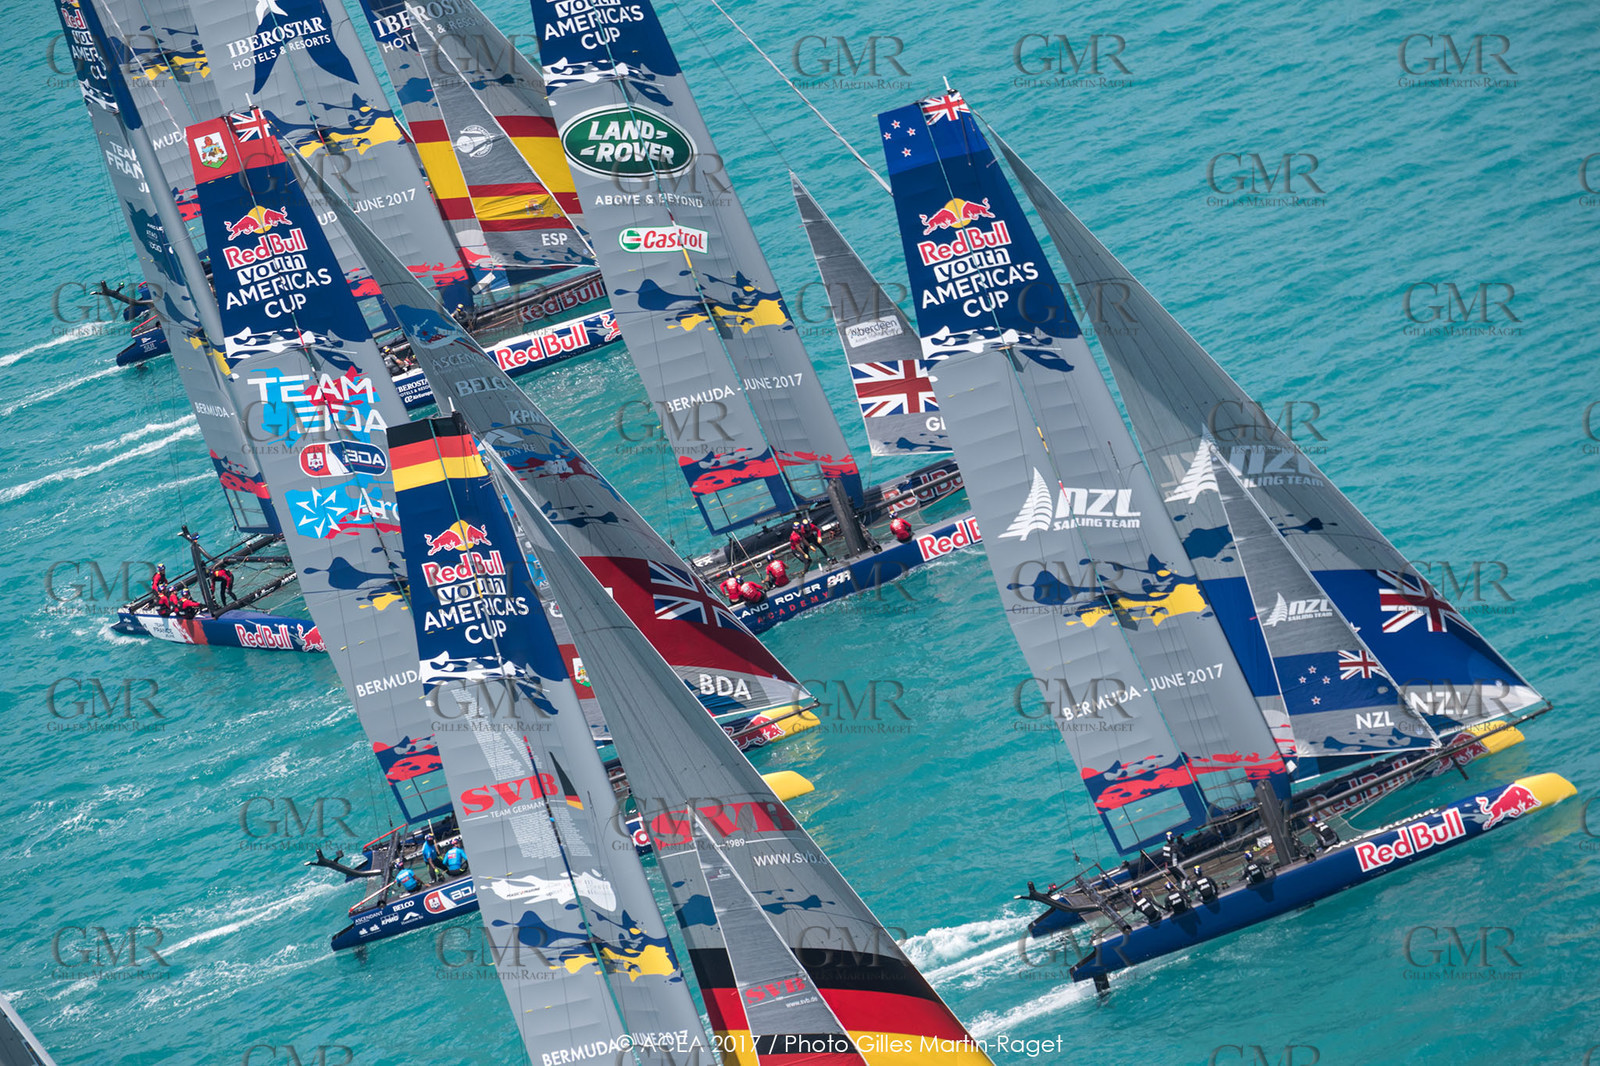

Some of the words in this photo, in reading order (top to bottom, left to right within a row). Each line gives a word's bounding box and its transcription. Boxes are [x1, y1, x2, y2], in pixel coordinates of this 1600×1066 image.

[545, 5, 644, 41] AMERICA'S
[227, 17, 326, 59] IBEROSTAR
[581, 26, 620, 50] CUP
[233, 49, 278, 71] HOTELS
[279, 45, 288, 56] &
[289, 34, 331, 52] RESORTS
[589, 120, 656, 141] LAND
[594, 142, 675, 165] ROVER
[354, 196, 384, 213] JUNE
[386, 188, 416, 206] 2017
[595, 194, 640, 206] ABOVE
[645, 194, 653, 204] &
[659, 193, 703, 208] BEYOND
[223, 235, 271, 270] Red
[267, 228, 308, 255] Bull
[541, 233, 568, 246] ESP
[644, 229, 704, 250] Castrol
[917, 235, 971, 266] Red
[967, 221, 1012, 249] Bull
[921, 262, 1038, 309] AMERICA'S
[264, 293, 306, 318] CUP
[517, 295, 561, 324] Red
[963, 290, 1009, 317] CUP
[495, 337, 544, 371] Red
[543, 321, 591, 357] Bull
[247, 373, 374, 403] TEAM
[666, 385, 734, 412] BERMUDA
[744, 377, 773, 391] JUNE
[773, 372, 803, 388] 2017
[194, 402, 230, 418] BERMUDA
[295, 404, 388, 434] BDA
[1055, 487, 1141, 519] NZL
[1053, 517, 1103, 531] SAILING
[1105, 518, 1140, 529] TEAM
[916, 520, 970, 561] Red
[421, 552, 475, 588] Red
[472, 550, 506, 576] Bull
[757, 591, 828, 623] ACADEMY
[774, 583, 821, 605] ROVER
[1289, 599, 1333, 614] NZL
[424, 596, 530, 631] AMERICA'S
[1311, 611, 1333, 619] TEAM
[235, 624, 267, 648] Red
[262, 624, 294, 650] Bull
[465, 619, 507, 644] CUP
[700, 673, 752, 700] BDA
[1063, 686, 1141, 721] BERMUDA
[1151, 672, 1186, 693] JUNE
[1187, 663, 1224, 685] 2017
[1410, 691, 1470, 716] NZL
[1356, 710, 1395, 731] NZL
[460, 772, 559, 816] SVB
[490, 808, 511, 819] TEAM
[651, 801, 797, 850] SVB
[725, 838, 746, 848] 1989
[1354, 826, 1414, 872] Red
[1408, 807, 1466, 852] Bull
[393, 900, 415, 912] BELCO
[745, 977, 806, 1005] SVB
